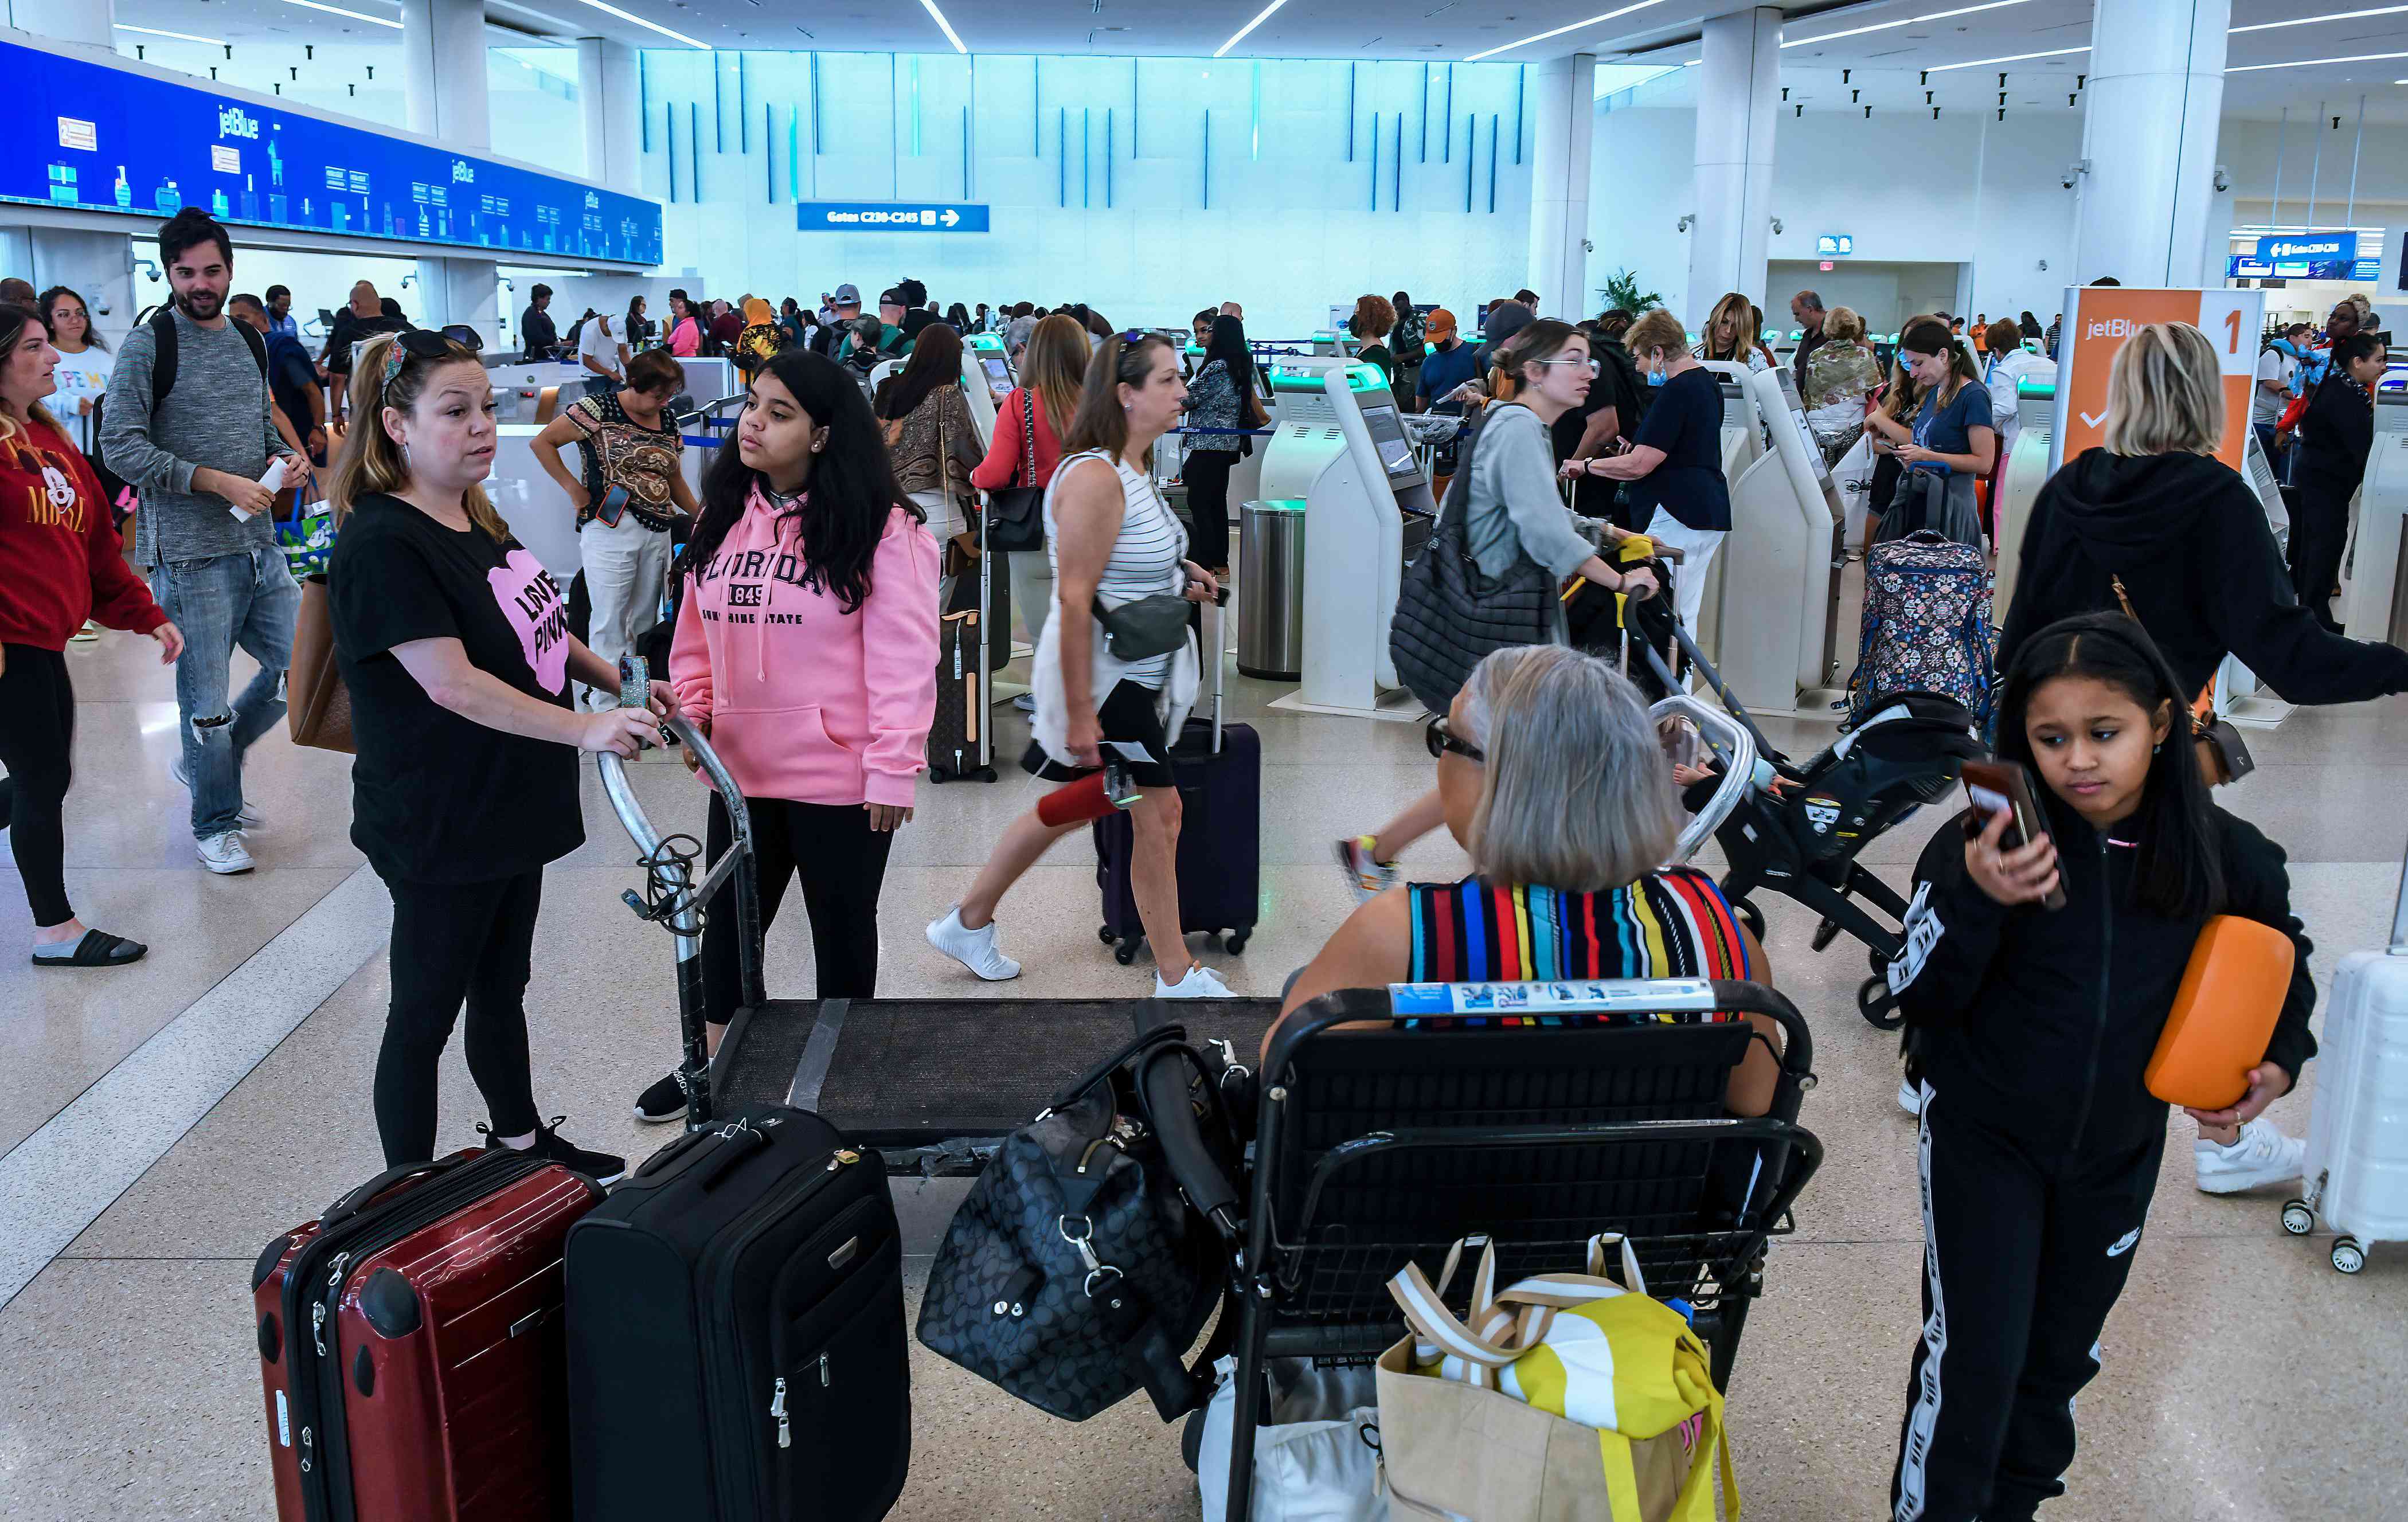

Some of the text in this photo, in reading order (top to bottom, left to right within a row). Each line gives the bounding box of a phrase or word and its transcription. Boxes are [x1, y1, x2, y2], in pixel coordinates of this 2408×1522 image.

[218, 104, 259, 139] jetBlue
[827, 211, 859, 222] Gates
[2085, 318, 2145, 341] jetBlu
[2225, 310, 2242, 354] 1
[514, 569, 560, 622] LOVE
[702, 609, 756, 624] SUNHINE
[533, 605, 568, 664] PINK
